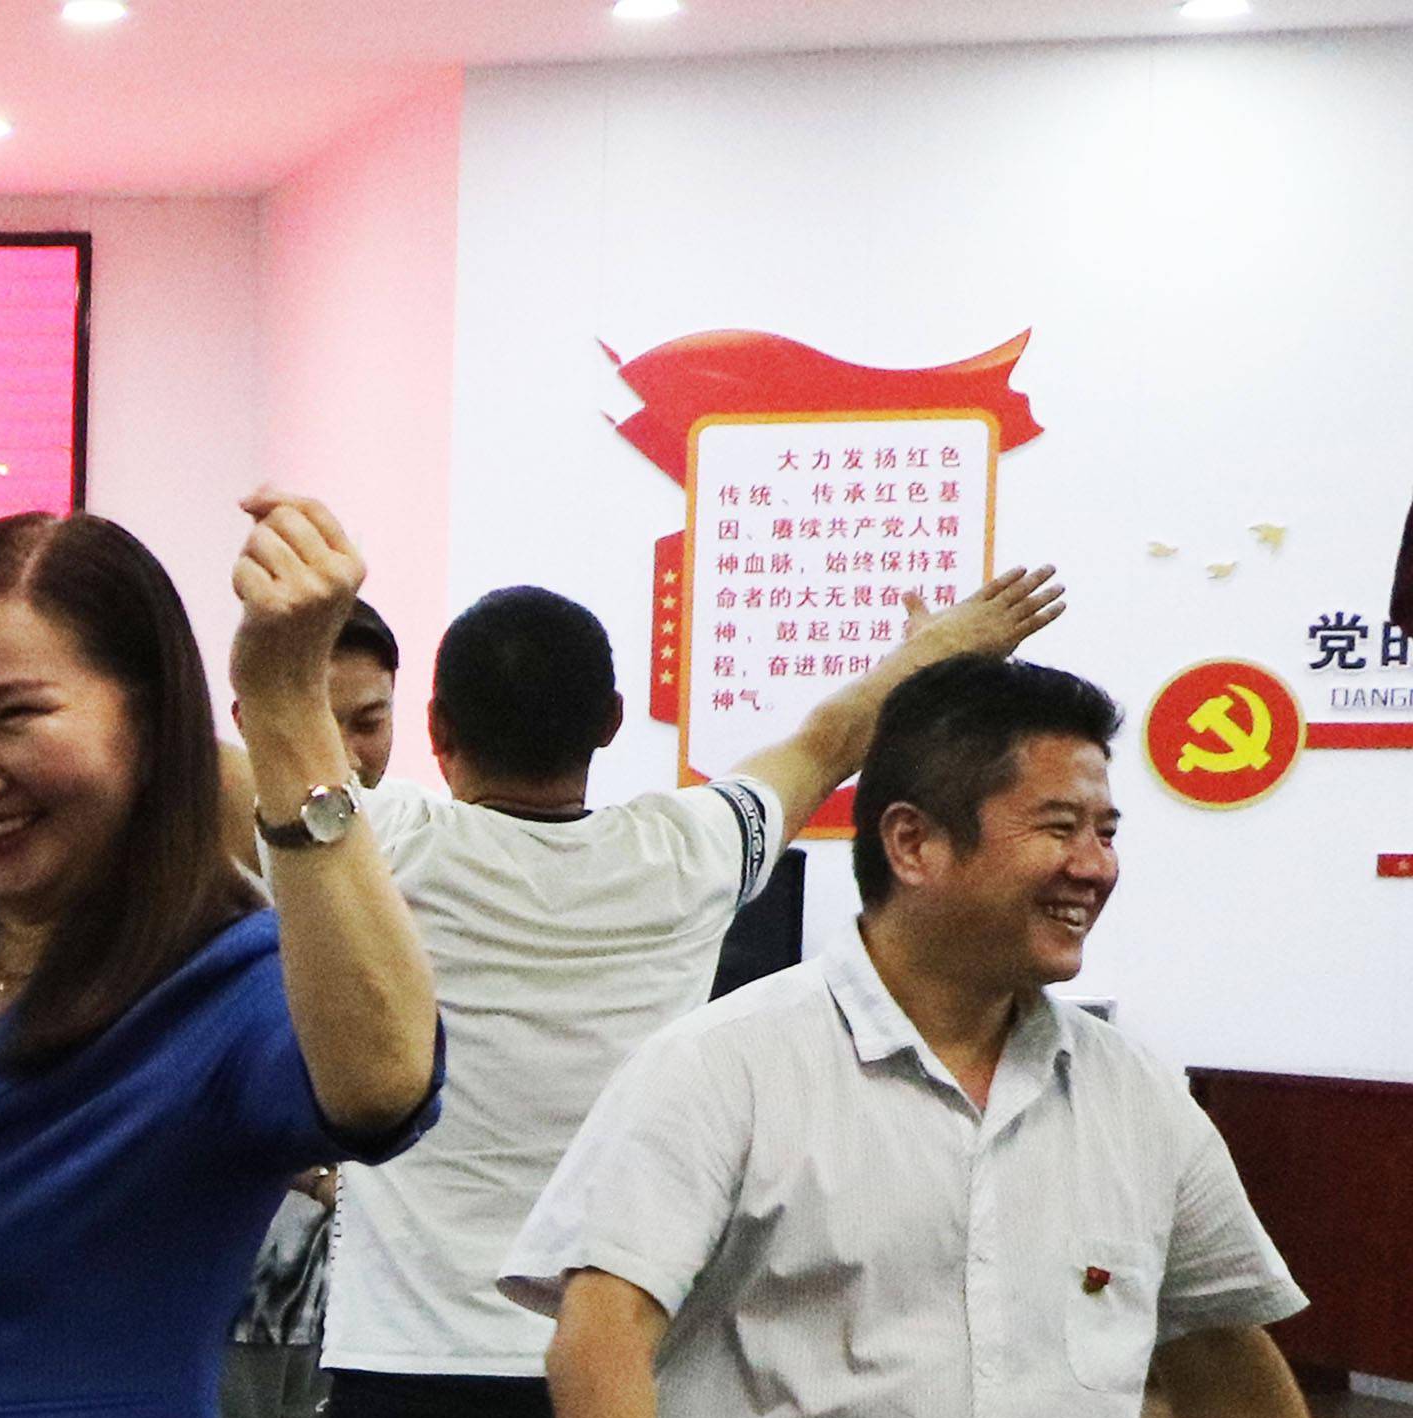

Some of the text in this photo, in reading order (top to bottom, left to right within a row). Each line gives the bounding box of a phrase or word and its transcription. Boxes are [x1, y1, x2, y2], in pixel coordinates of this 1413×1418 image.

[777, 445, 961, 472] 大力发扬红色
[718, 480, 961, 507] 传统、传承红色基
[714, 620, 910, 643] 神，鼓起迈进
[713, 654, 883, 677] 程，奋进新时
